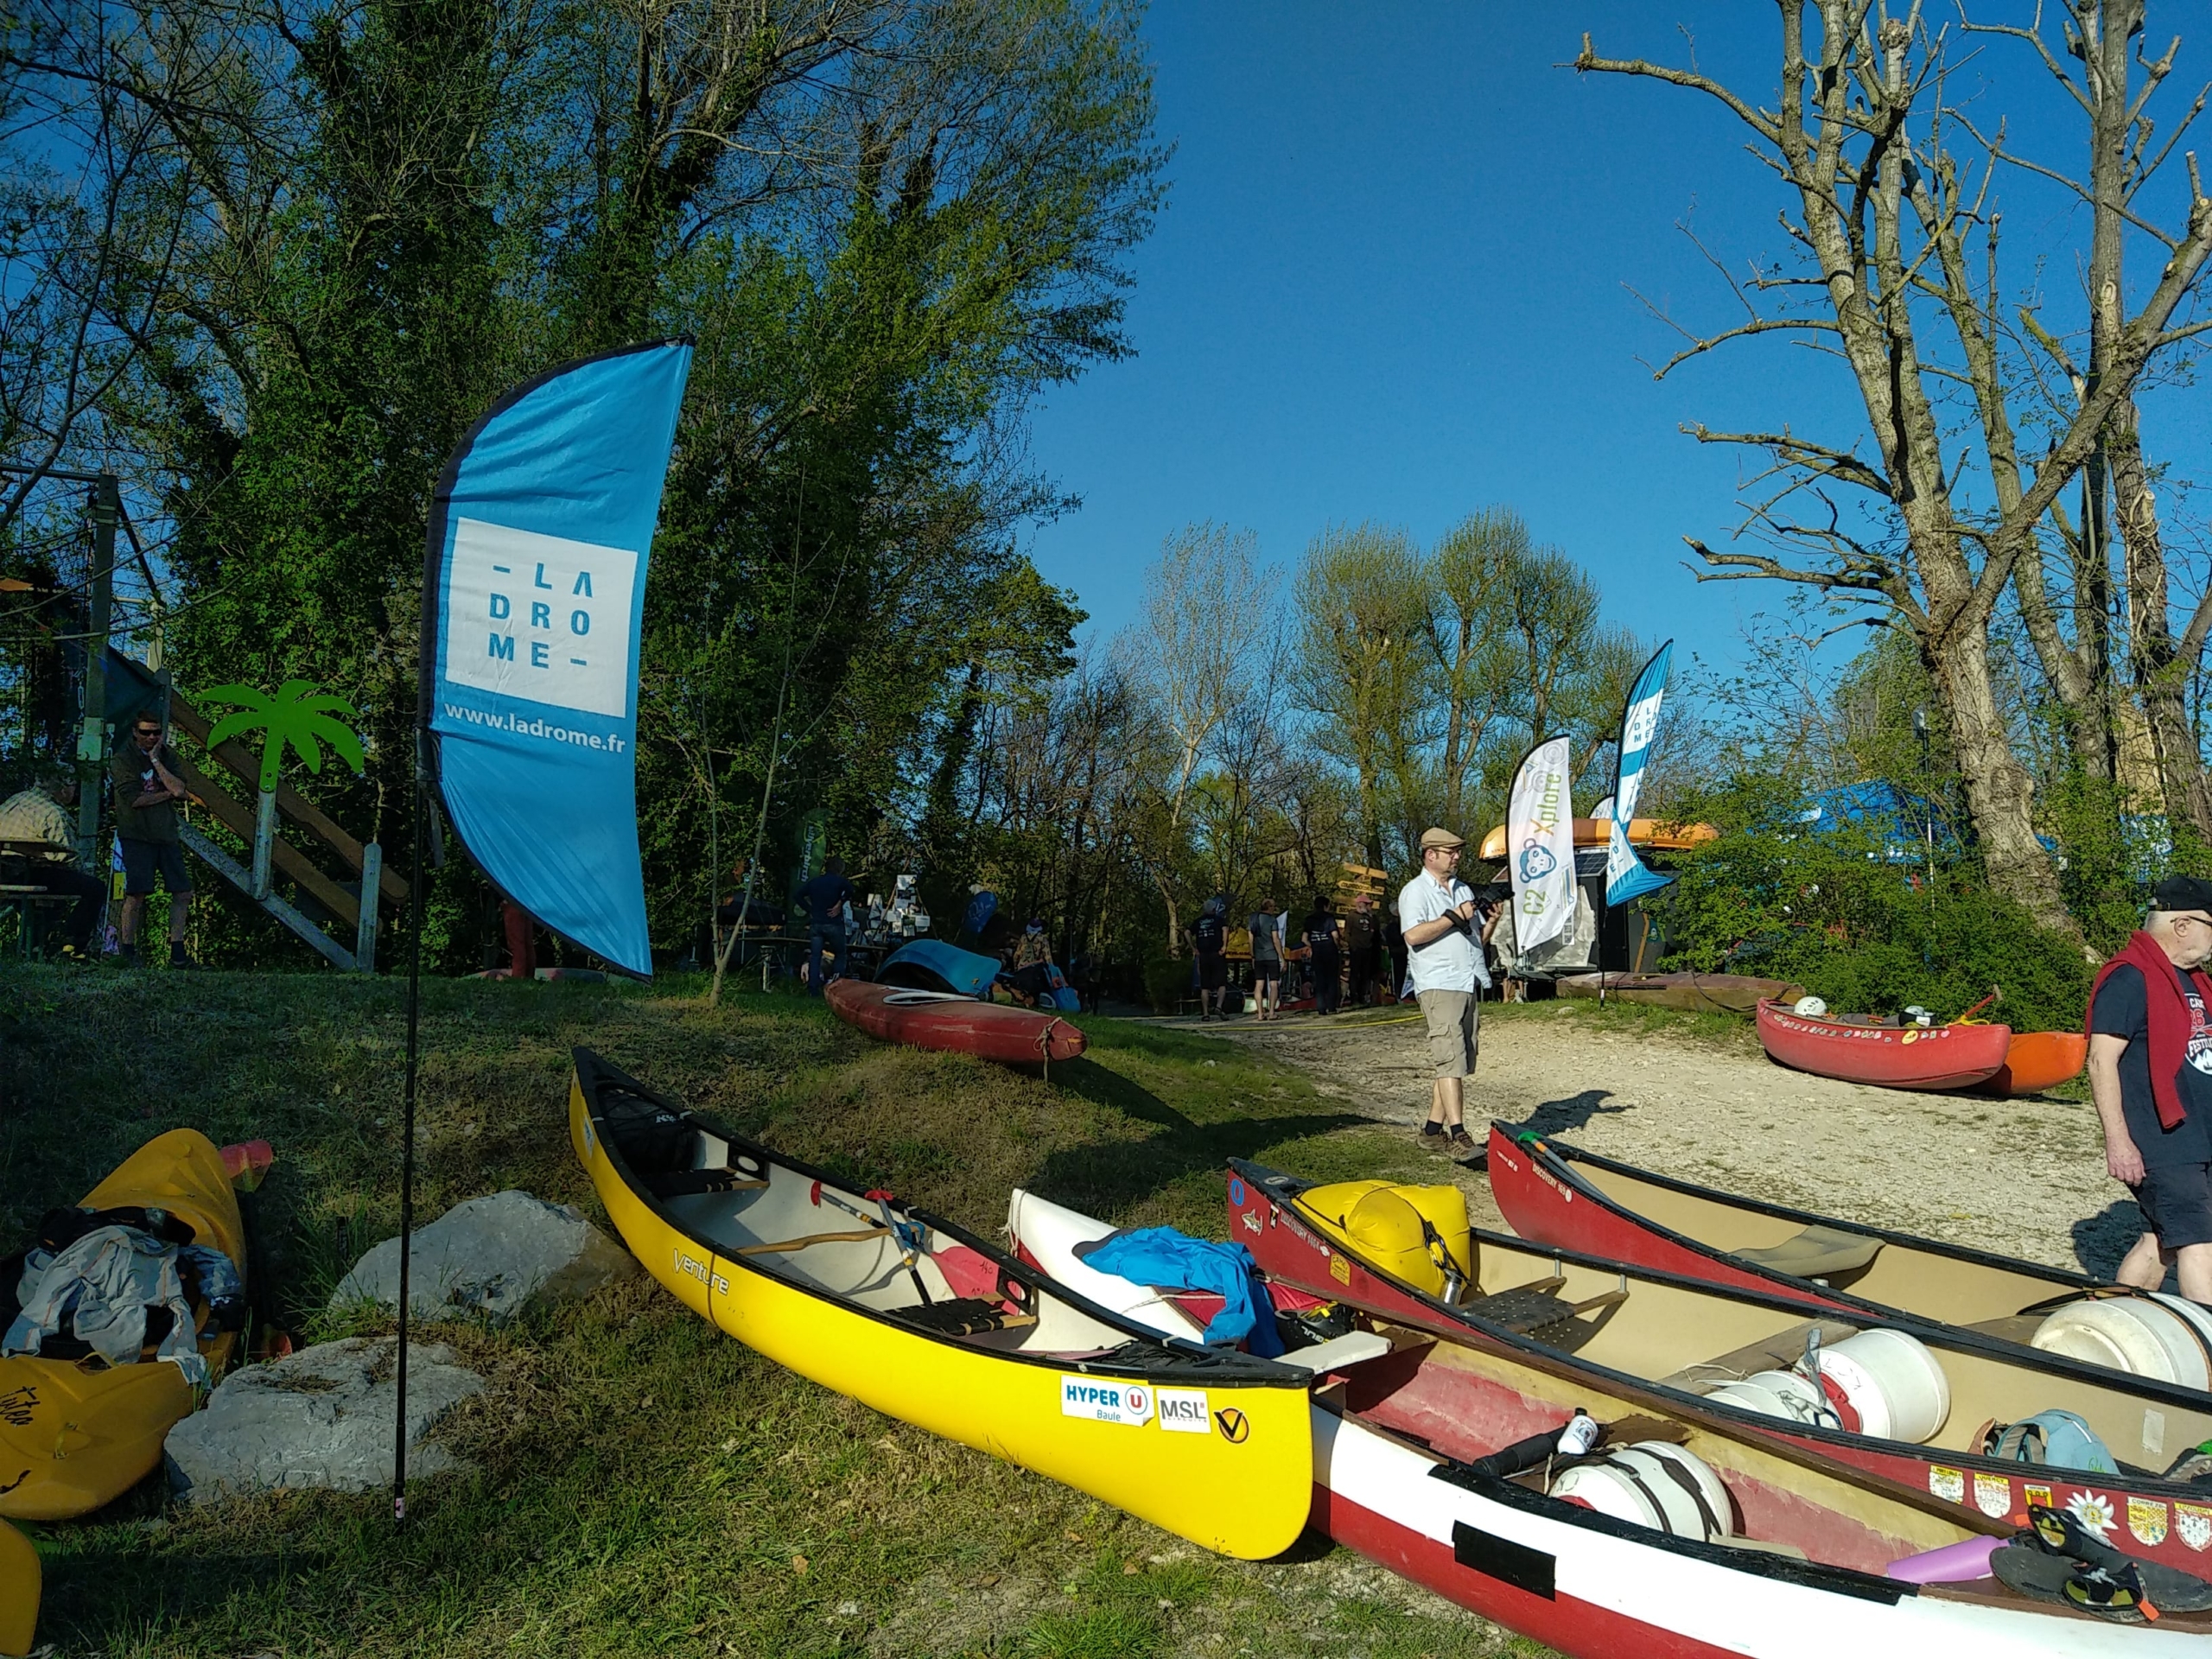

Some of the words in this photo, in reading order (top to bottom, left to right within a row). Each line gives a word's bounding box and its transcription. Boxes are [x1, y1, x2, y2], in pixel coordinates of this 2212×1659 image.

[443, 702, 626, 753] www.ladrome.fr
[1530, 772, 1561, 837] Xplore
[1523, 888, 1547, 916] C2
[1532, 1163, 1557, 1189] DISCOVERY
[1280, 1211, 1307, 1241] DISCOVERY
[673, 1248, 729, 1296] Venture
[1066, 1384, 1120, 1408] HYPER
[1130, 1394, 1142, 1409] U
[1160, 1400, 1206, 1420] MSL
[1096, 1409, 1121, 1422] Baule
